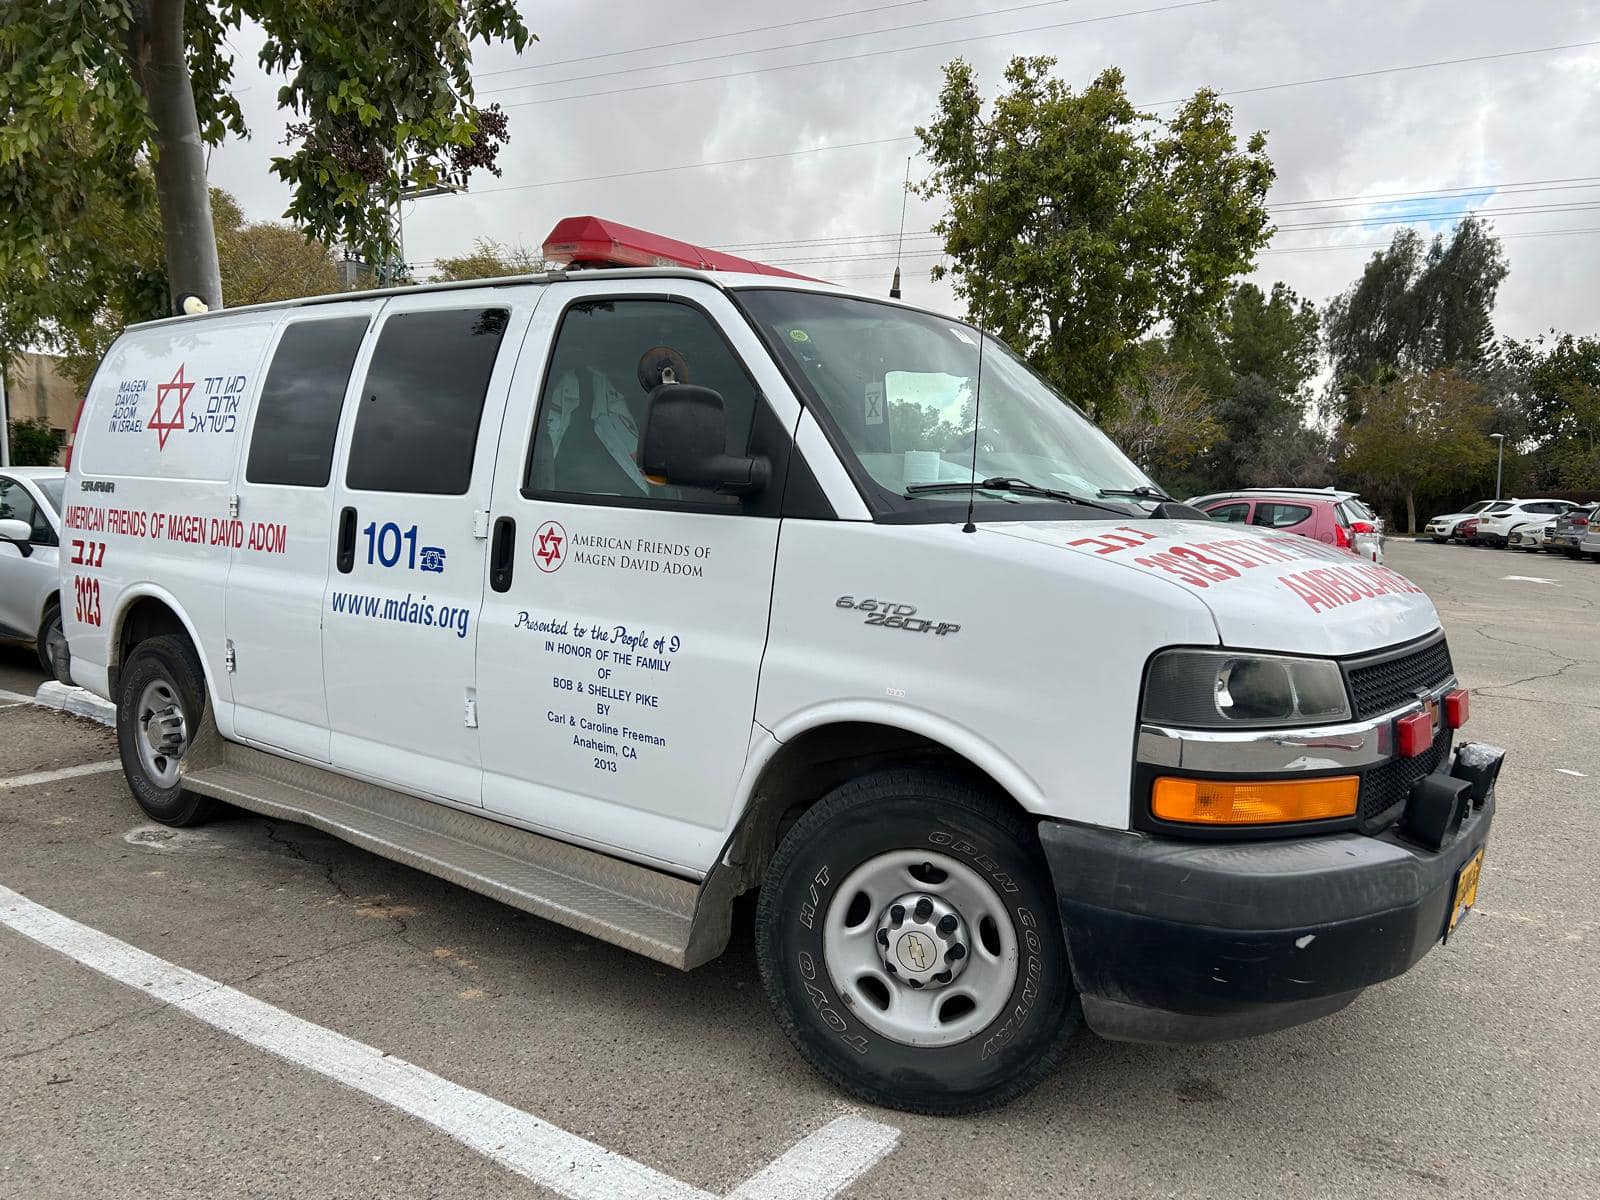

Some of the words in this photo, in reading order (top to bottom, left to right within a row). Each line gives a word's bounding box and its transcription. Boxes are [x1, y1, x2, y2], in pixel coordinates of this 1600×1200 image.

[119, 380, 149, 392] MAGEN
[204, 377, 224, 394] דוד
[224, 376, 247, 395] מגן
[114, 394, 139, 406] DAVID
[206, 395, 241, 414] אדום
[112, 407, 137, 419] ADOM
[188, 412, 237, 433] בישראל
[108, 420, 118, 433] IN
[118, 420, 144, 433] ISRAEL
[65, 506, 105, 532] AMERICAN
[107, 509, 147, 538] FRIENDS
[150, 512, 165, 539] OF
[167, 515, 207, 545] MAGEN
[210, 519, 244, 549] DAVID
[248, 522, 288, 554] ADOM
[71, 539, 106, 568] נגב
[364, 522, 417, 570] 101
[1133, 546, 1242, 588] 3123
[74, 575, 101, 627] 3123
[835, 596, 918, 616] 6.6TD
[332, 592, 470, 638] www.mdais.org
[863, 612, 961, 636] 260HP
[514, 611, 568, 636] Presented
[573, 622, 588, 638] to
[591, 625, 609, 642] the
[610, 626, 649, 651] People
[653, 636, 666, 655] of
[545, 641, 555, 652] IN
[558, 642, 592, 659] HONOR
[596, 649, 609, 661] OF
[613, 652, 632, 666] THE
[636, 656, 671, 673] FAMILY
[598, 667, 612, 680] OF
[553, 677, 573, 691] BOB
[577, 682, 584, 693] &
[588, 684, 632, 702] SHELLEY
[636, 693, 659, 708] PIKE
[597, 703, 611, 716] BY
[547, 711, 566, 725] Carl
[570, 716, 577, 727] &
[580, 718, 619, 736] Caroline
[623, 728, 666, 747] Freeman
[573, 735, 618, 757] Anaheim,
[622, 746, 638, 760] CA
[594, 758, 617, 773] 2013
[928, 831, 1019, 893] OPEN
[798, 952, 868, 1055] TOYO
